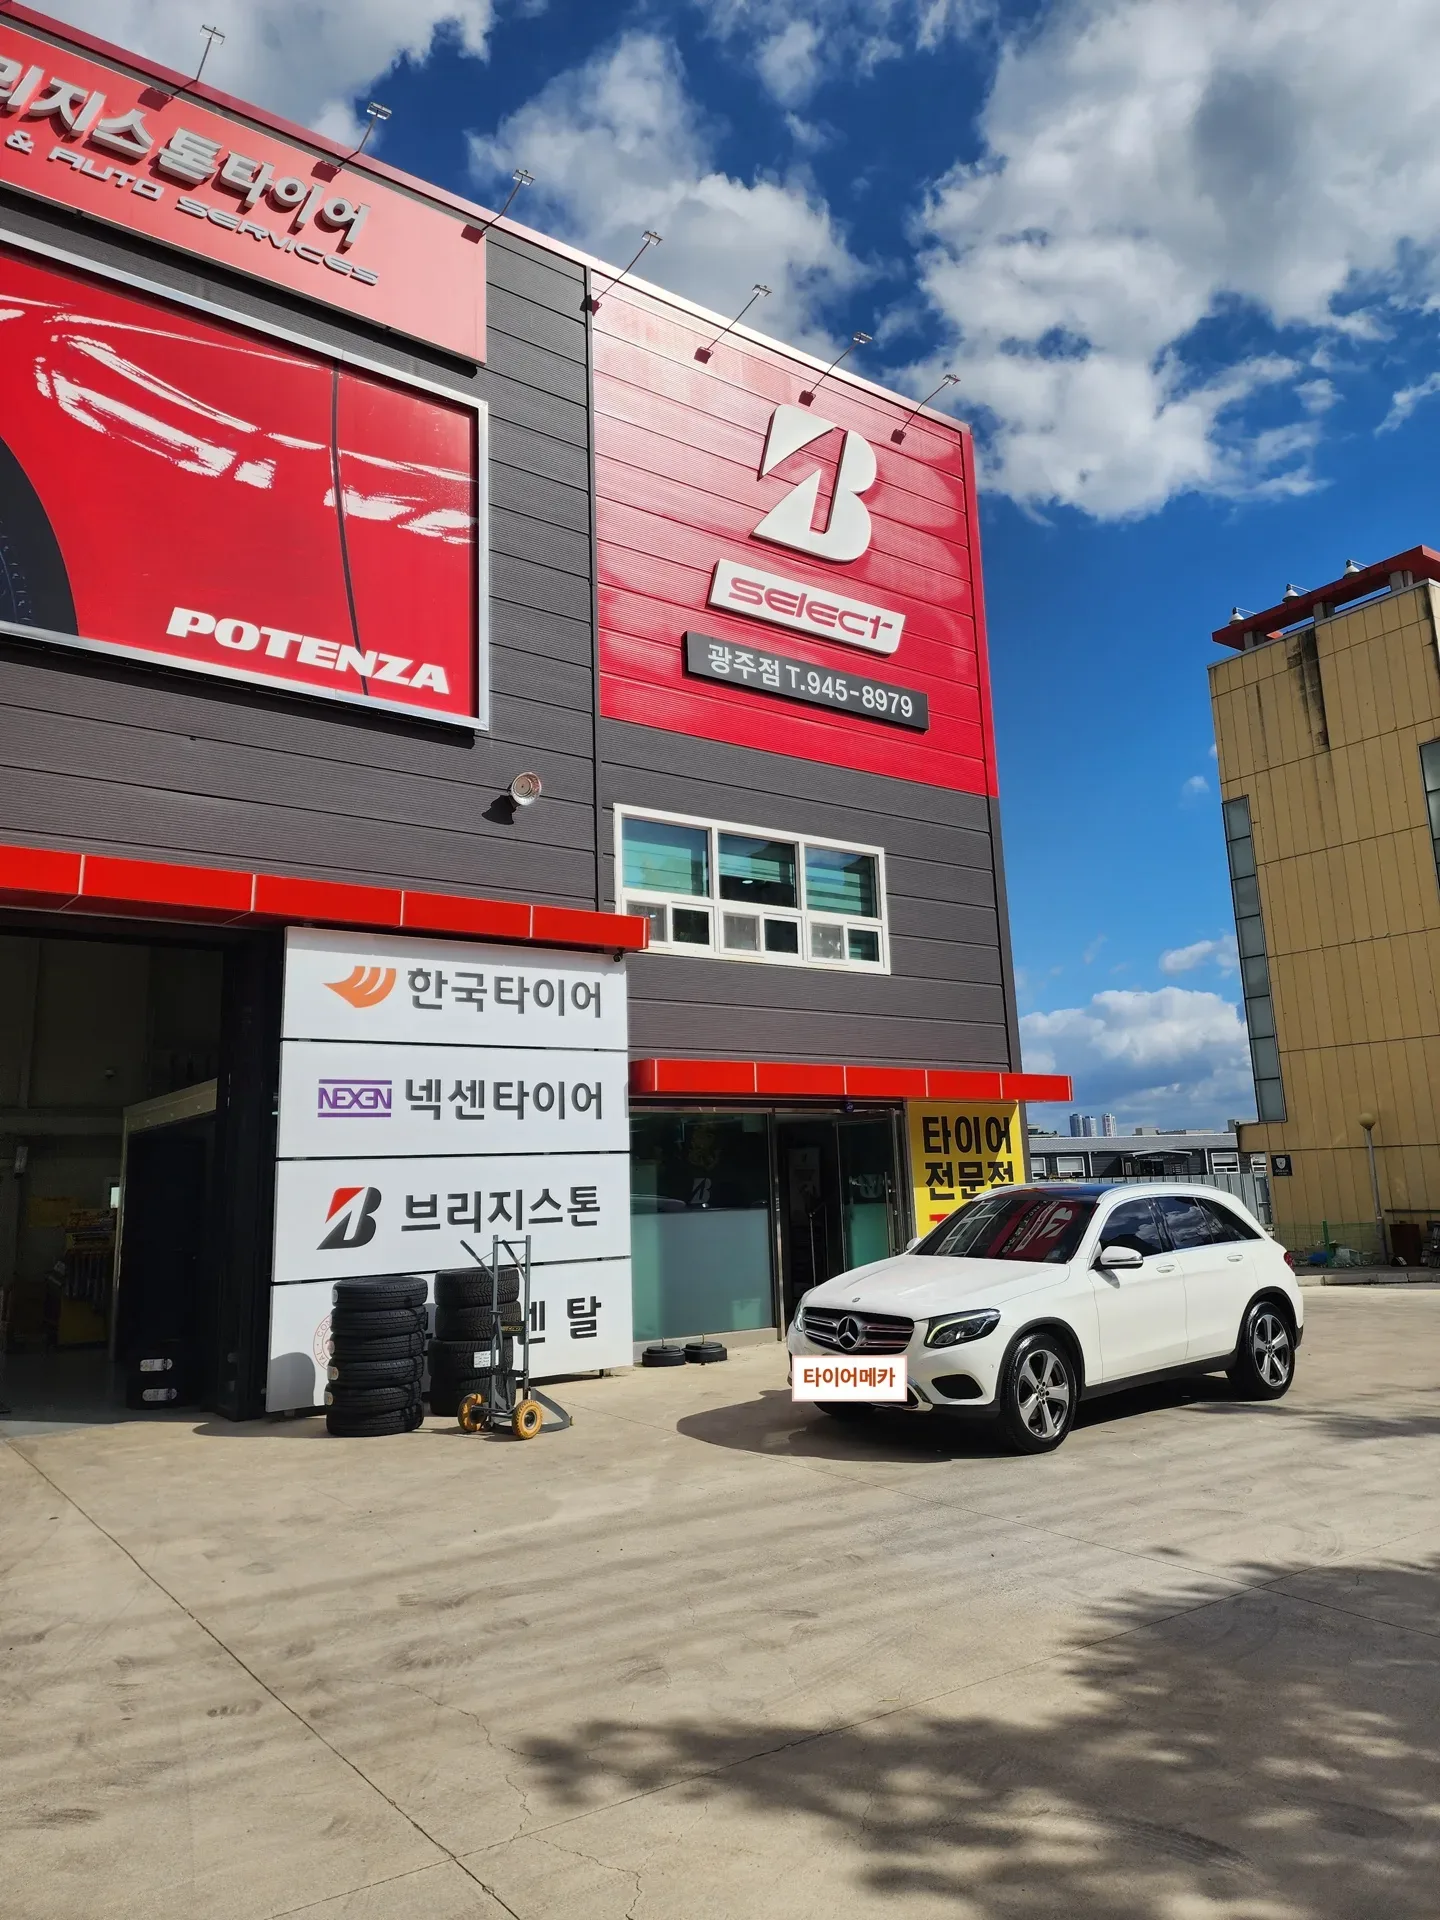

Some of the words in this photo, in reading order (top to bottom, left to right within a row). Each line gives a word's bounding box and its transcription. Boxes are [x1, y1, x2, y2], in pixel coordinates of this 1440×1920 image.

[5, 130, 34, 155] &
[47, 146, 164, 200] AUTO
[175, 196, 379, 287] SERVICES
[166, 607, 451, 695] POTENZA
[708, 643, 780, 688] 광주점
[785, 664, 913, 718] T.945-8979
[407, 967, 602, 1019] 한국타이어
[318, 1086, 392, 1110] NEXEN
[405, 1078, 603, 1121] 넥센타이어
[922, 1115, 1012, 1155] 타이어
[401, 1185, 600, 1234] 브리지스톤
